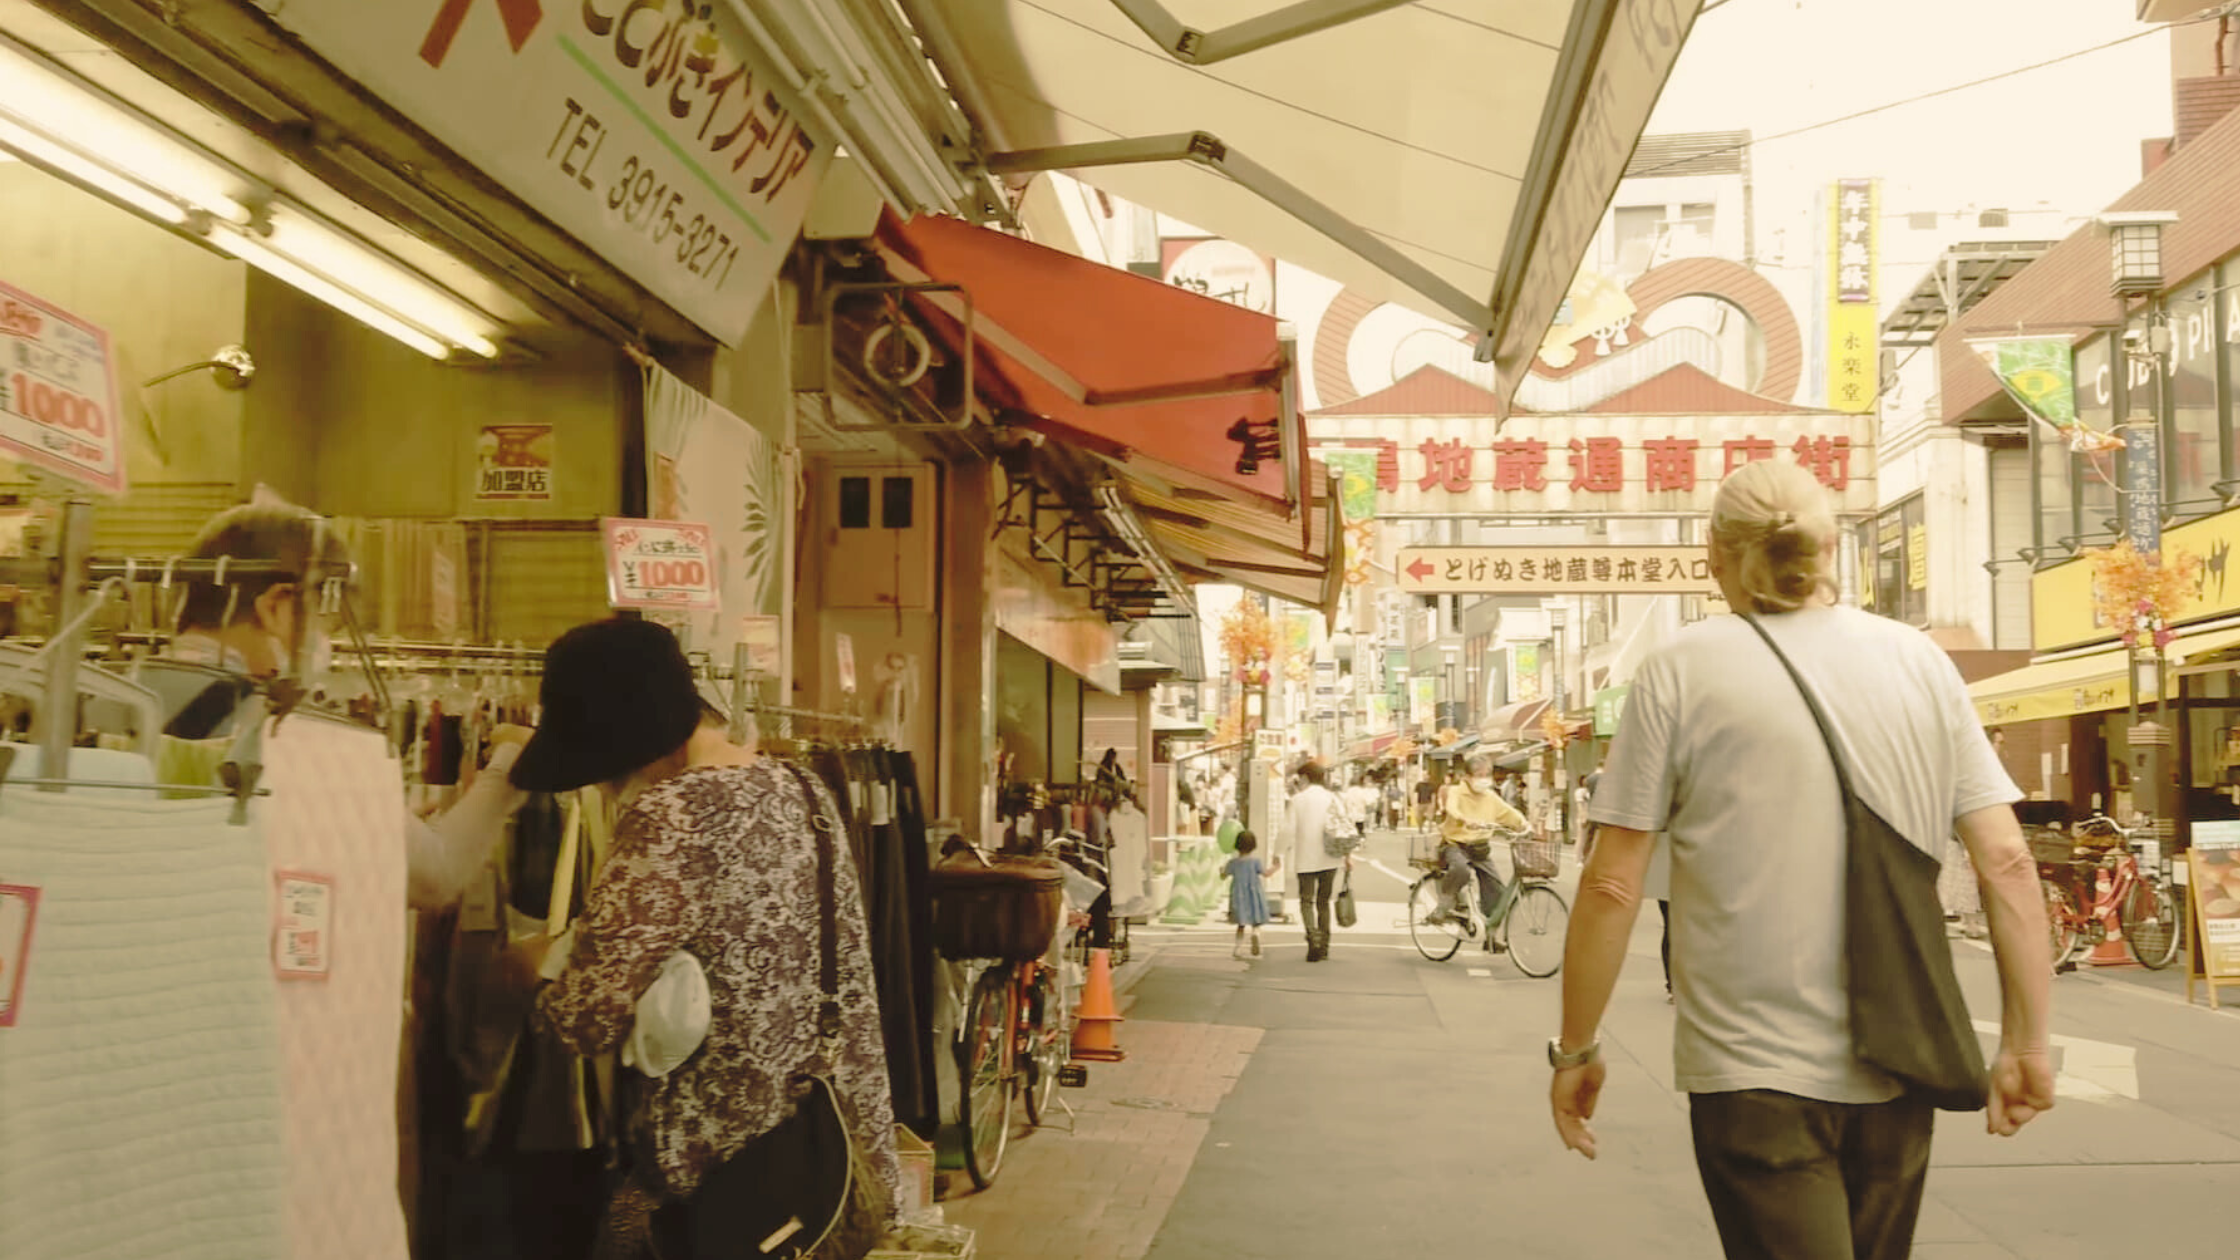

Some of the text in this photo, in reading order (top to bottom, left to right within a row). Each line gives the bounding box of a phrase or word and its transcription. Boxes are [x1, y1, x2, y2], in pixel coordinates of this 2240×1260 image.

[547, 97, 740, 292] TEL 3915-3271
[482, 470, 547, 492] 加盟店
[1444, 556, 1709, 583] とげぬき地蔵尊本堂入口
